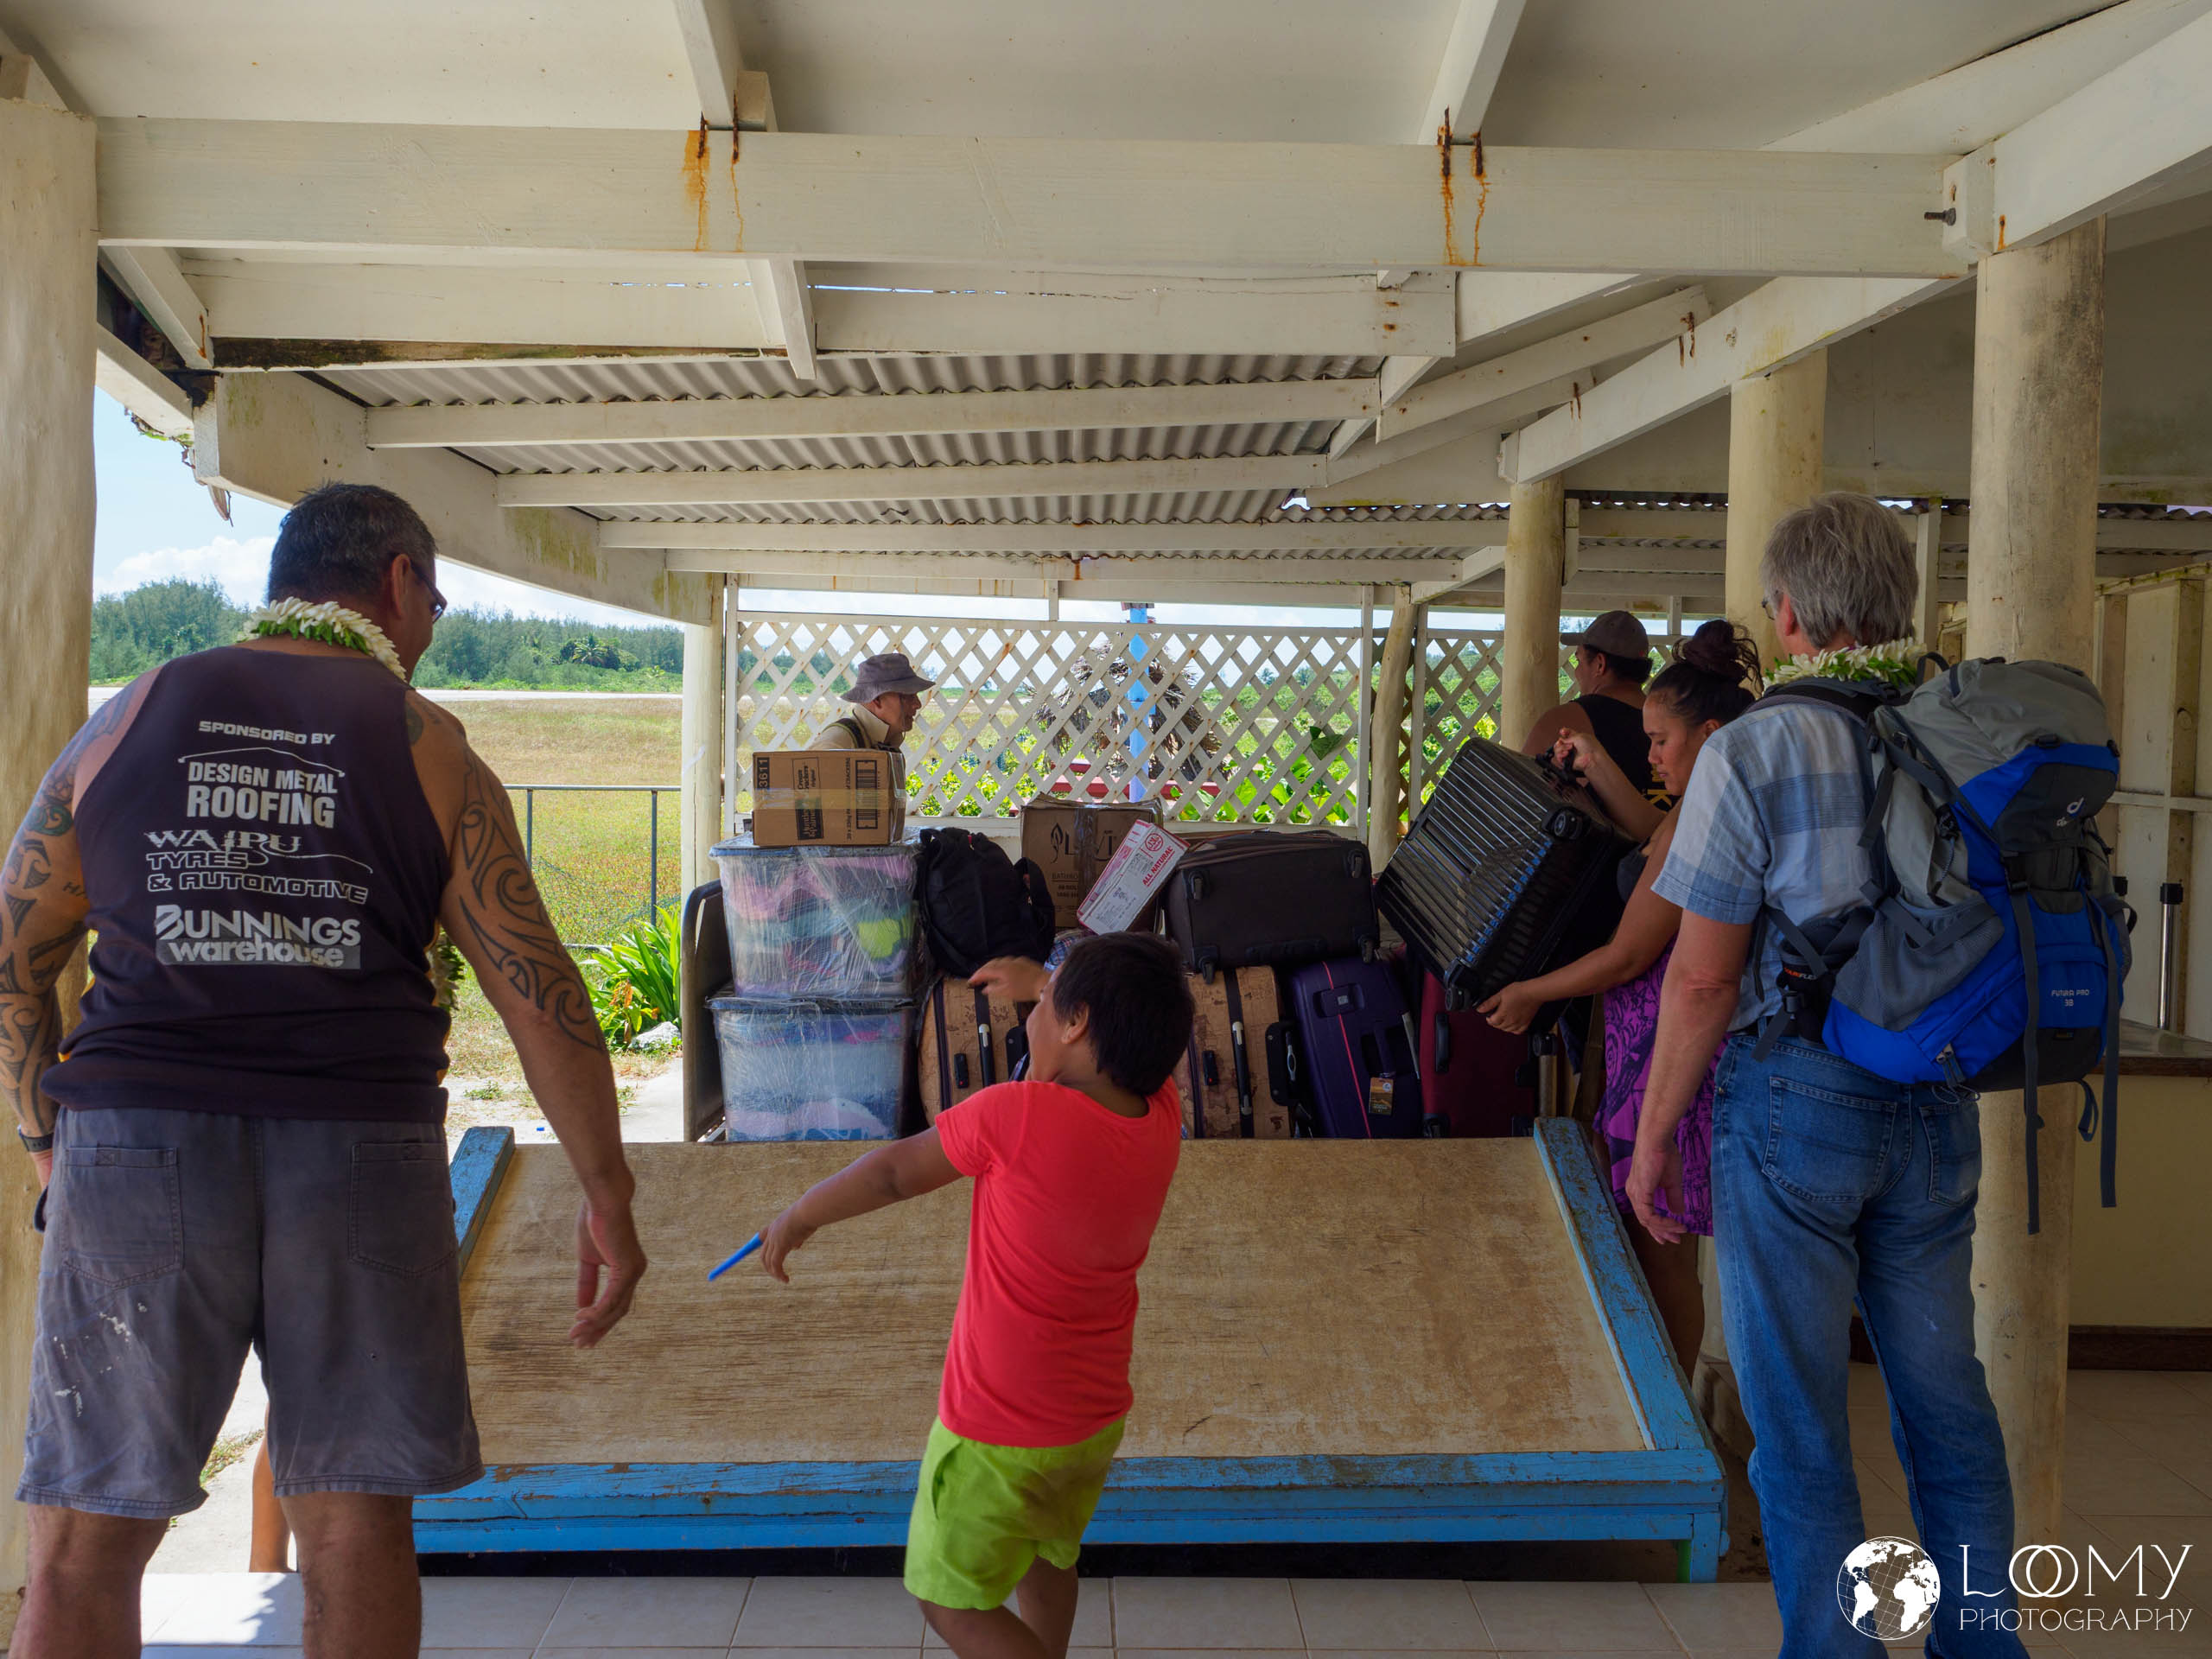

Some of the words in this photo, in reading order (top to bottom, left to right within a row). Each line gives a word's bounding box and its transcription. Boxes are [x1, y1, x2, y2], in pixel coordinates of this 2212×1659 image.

[199, 721, 306, 744] SPONSORED
[311, 733, 336, 745] BY
[188, 761, 270, 787] DESIGN
[275, 770, 338, 794] METAL
[187, 785, 336, 829] ROOFING
[146, 850, 249, 870] TYRES
[1142, 872, 1153, 887] ALL
[1150, 846, 1173, 874] NATURAL
[147, 874, 173, 892] &
[179, 871, 369, 905] AUTOMOTIVE
[155, 904, 362, 947] BUNNINGS
[168, 931, 346, 967] warehouse
